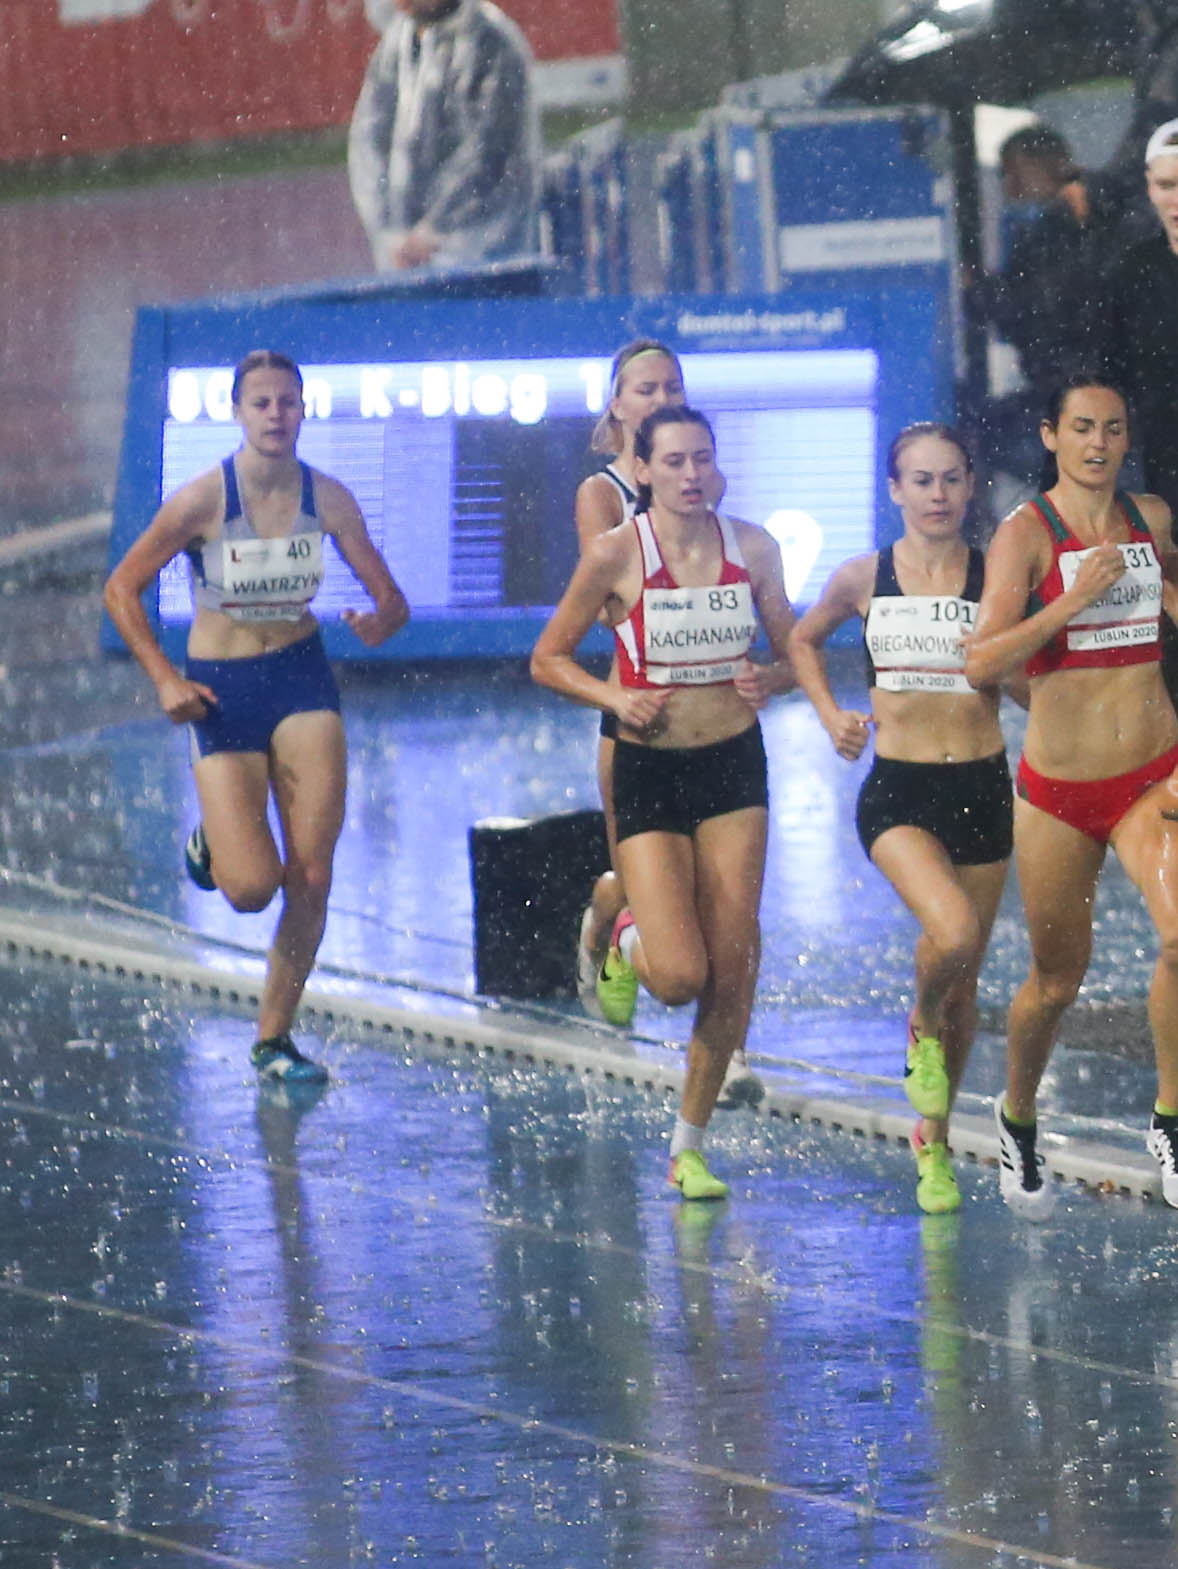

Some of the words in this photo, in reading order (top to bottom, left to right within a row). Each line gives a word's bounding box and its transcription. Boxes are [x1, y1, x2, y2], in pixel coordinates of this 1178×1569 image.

[287, 539, 311, 560] 40
[1121, 547, 1153, 569] 31
[708, 589, 738, 611] 83
[930, 600, 974, 625] 101
[1094, 629, 1129, 643] LUBLIN
[1133, 625, 1158, 639] 2020
[669, 669, 706, 681] LUBLIN
